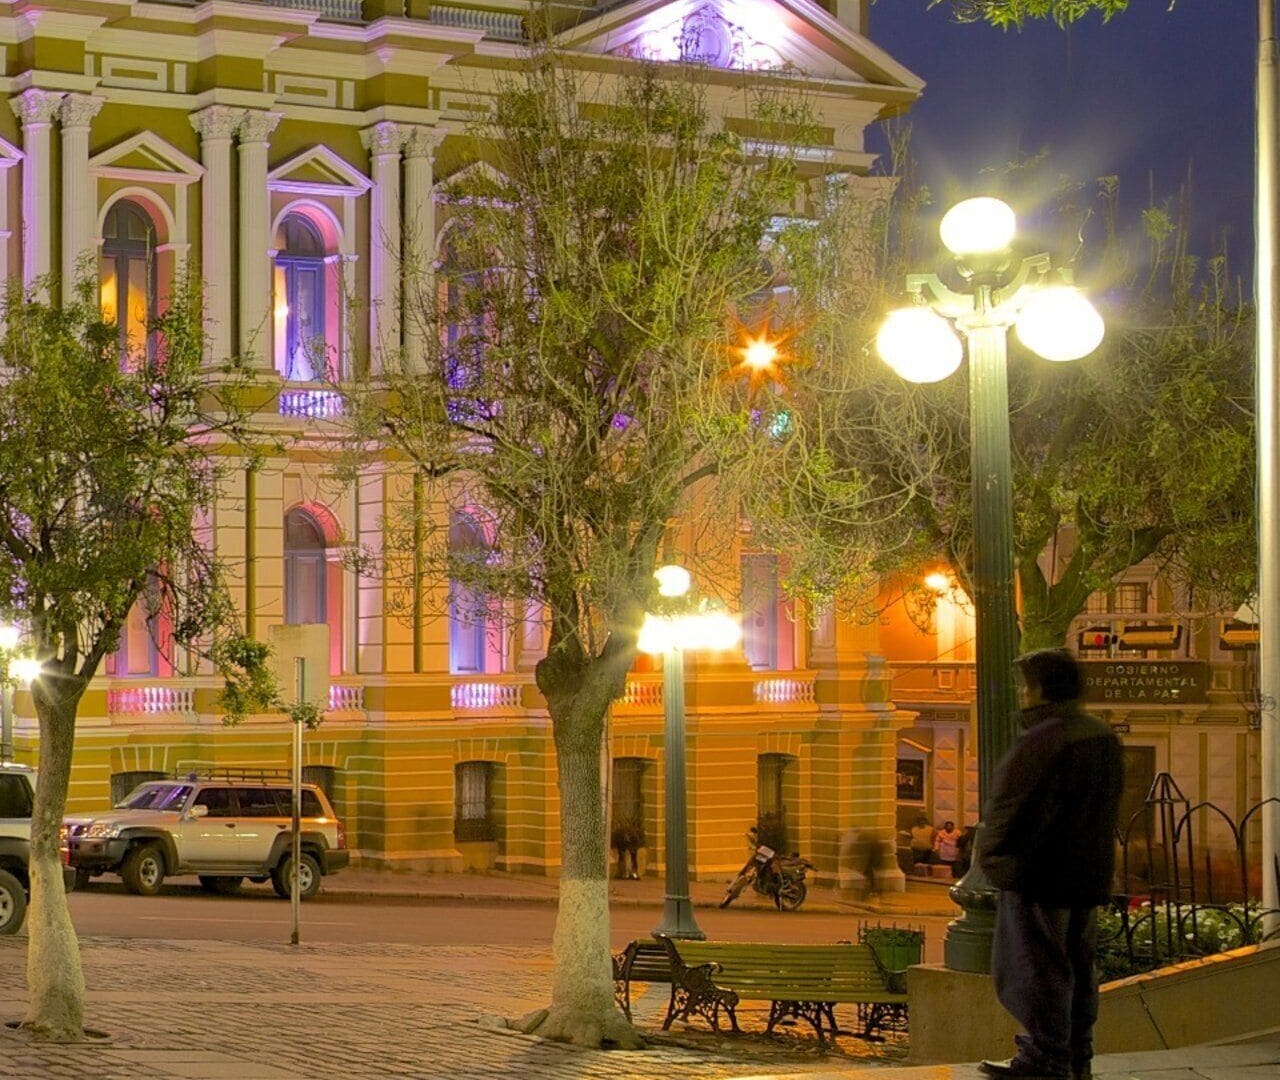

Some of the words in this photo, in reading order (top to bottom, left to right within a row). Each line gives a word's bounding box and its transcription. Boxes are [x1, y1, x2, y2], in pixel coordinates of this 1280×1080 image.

[1105, 665, 1180, 675] GOBIERNO
[1086, 677, 1198, 687] DEPARTAMENTAL
[1105, 689, 1122, 698] DE
[1128, 689, 1146, 698] LA
[1154, 689, 1180, 699] PAZ
